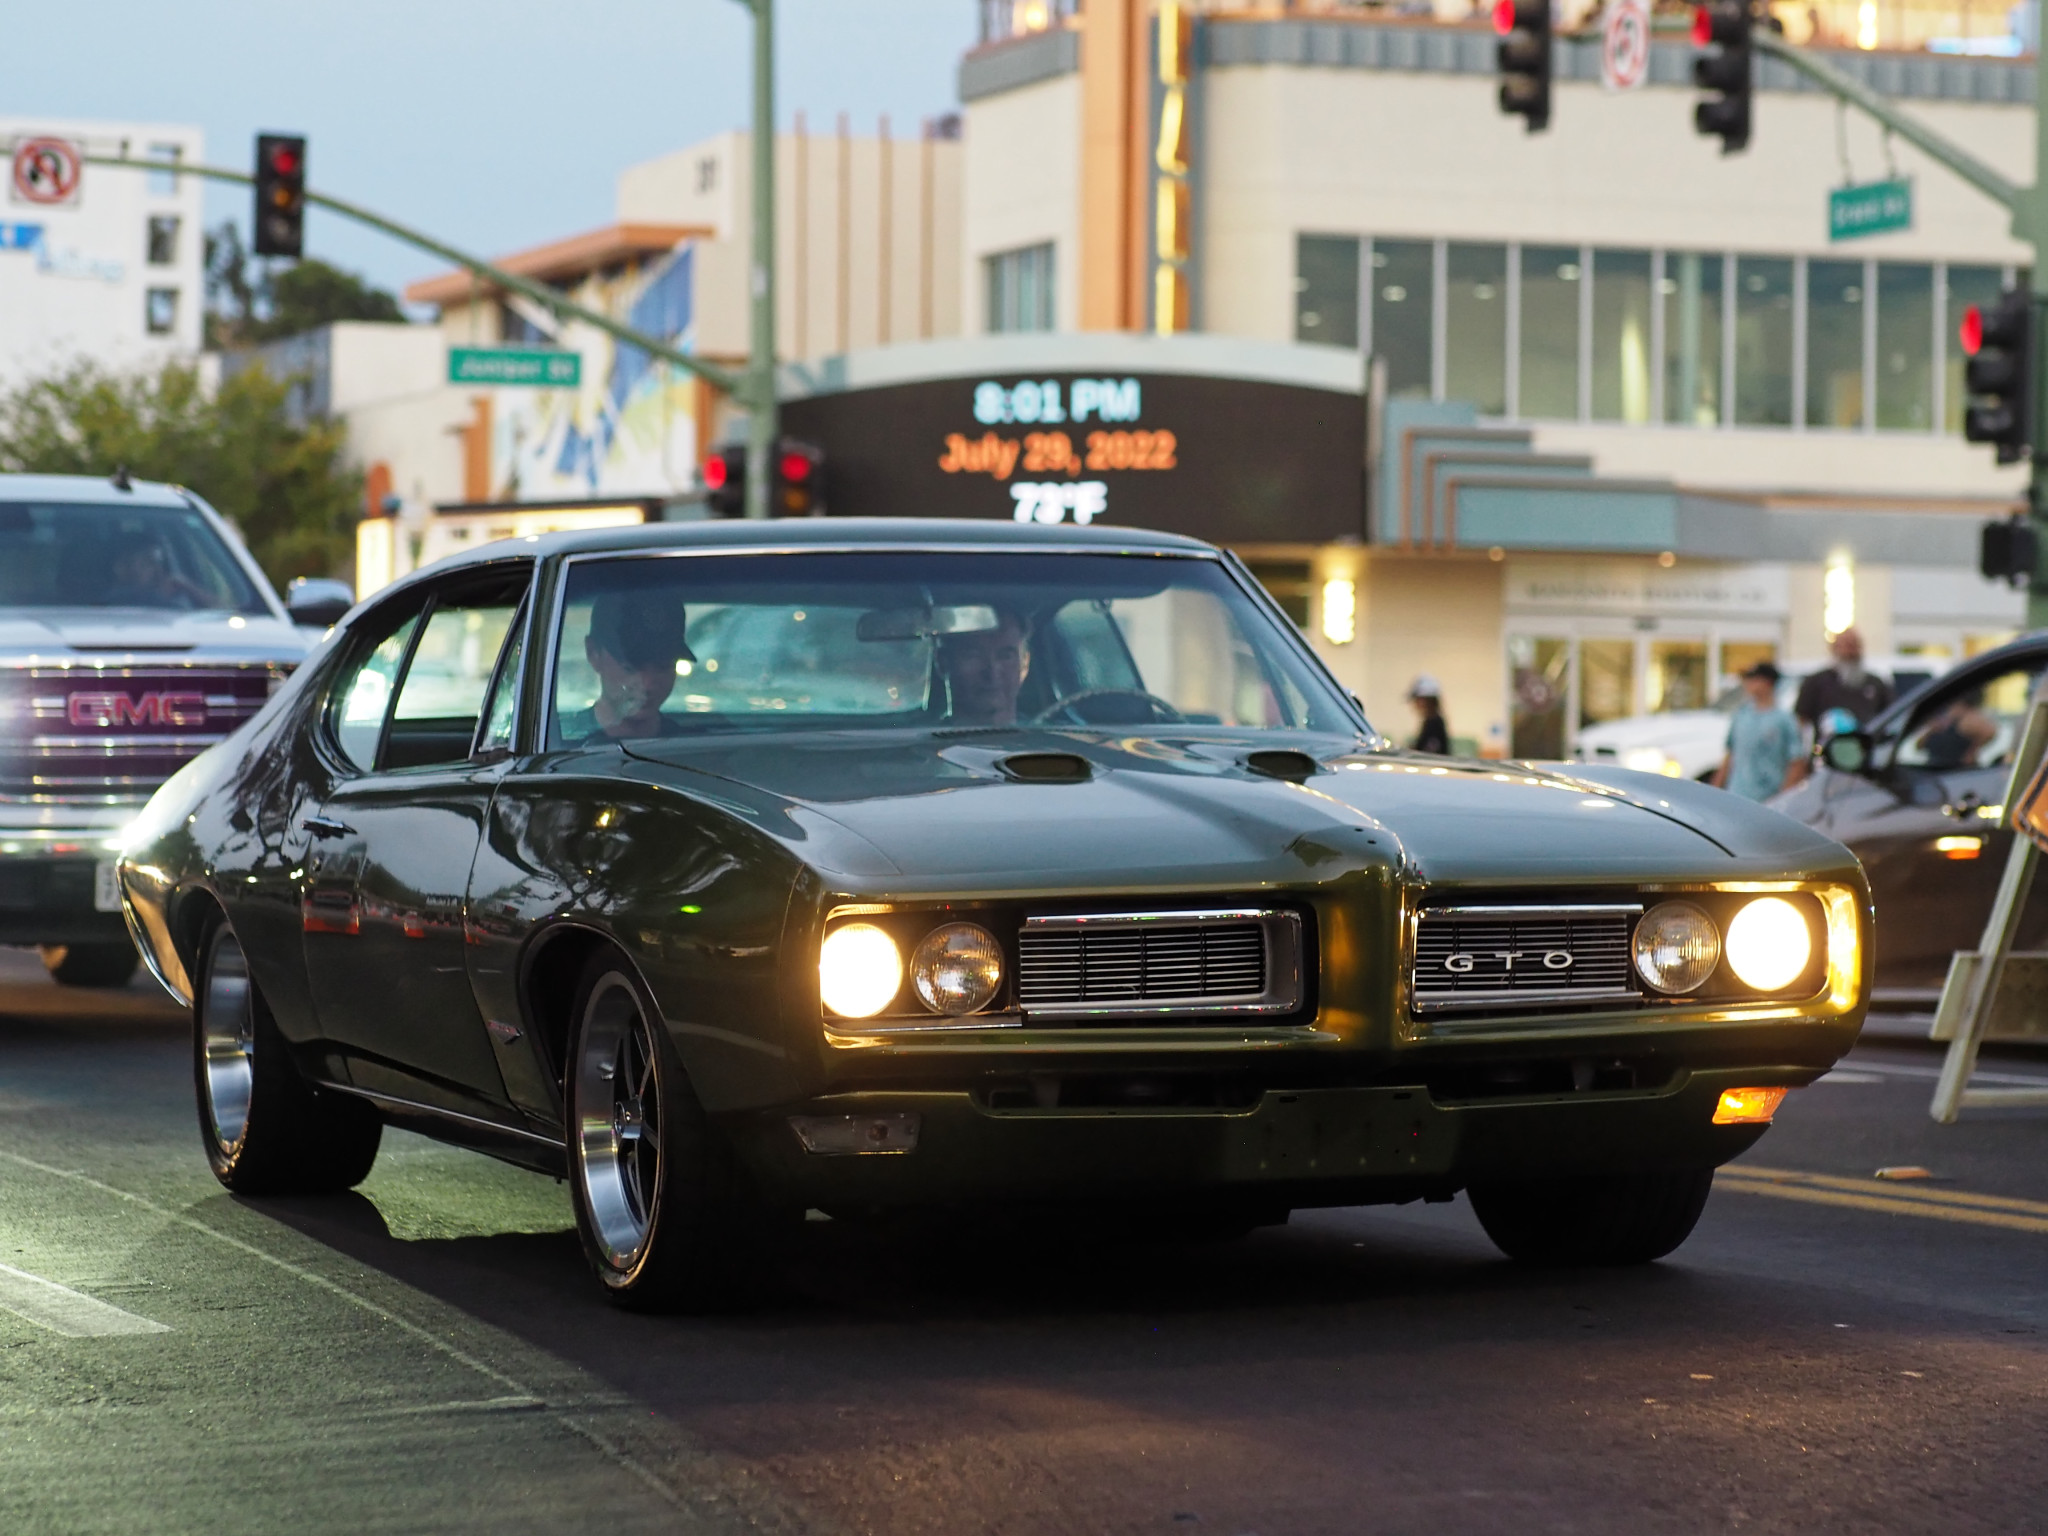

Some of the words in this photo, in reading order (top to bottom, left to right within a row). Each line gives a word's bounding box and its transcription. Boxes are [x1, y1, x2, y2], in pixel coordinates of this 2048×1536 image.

[973, 379, 1067, 425] 8:01
[1070, 377, 1141, 423] PM
[938, 431, 1020, 480] July
[1022, 431, 1082, 478] 29,
[1085, 429, 1177, 471] 2022
[67, 691, 205, 726] GMC
[1444, 951, 1574, 973] GTO
